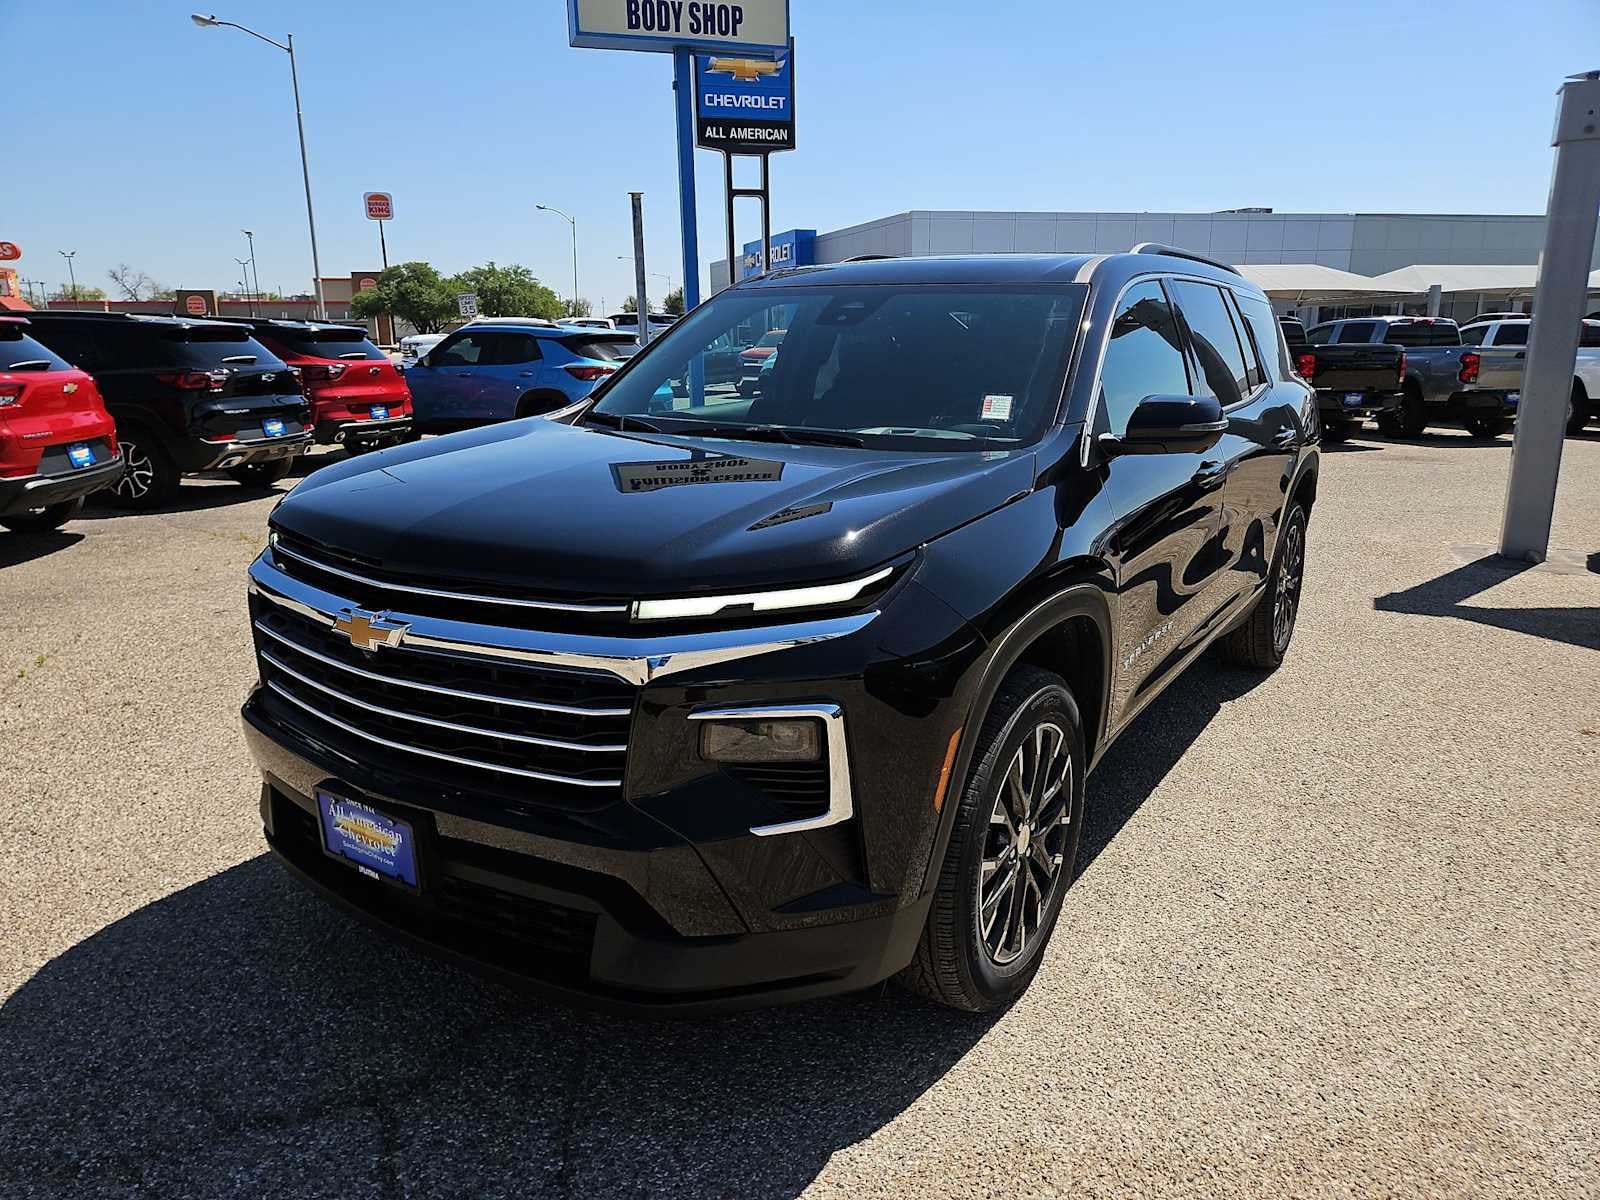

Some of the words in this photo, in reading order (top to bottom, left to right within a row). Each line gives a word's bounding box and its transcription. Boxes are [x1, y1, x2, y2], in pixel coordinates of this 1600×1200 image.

[626, 0, 683, 33] BODY
[688, 2, 743, 36] SHOP
[705, 94, 785, 109] CHEVROLET
[705, 126, 726, 139] ALL
[729, 128, 788, 141] AMERICAN
[368, 206, 390, 214] KING
[461, 305, 476, 314] 35
[328, 802, 345, 819] All
[348, 811, 403, 844] American
[339, 825, 397, 857] Chevrolet
